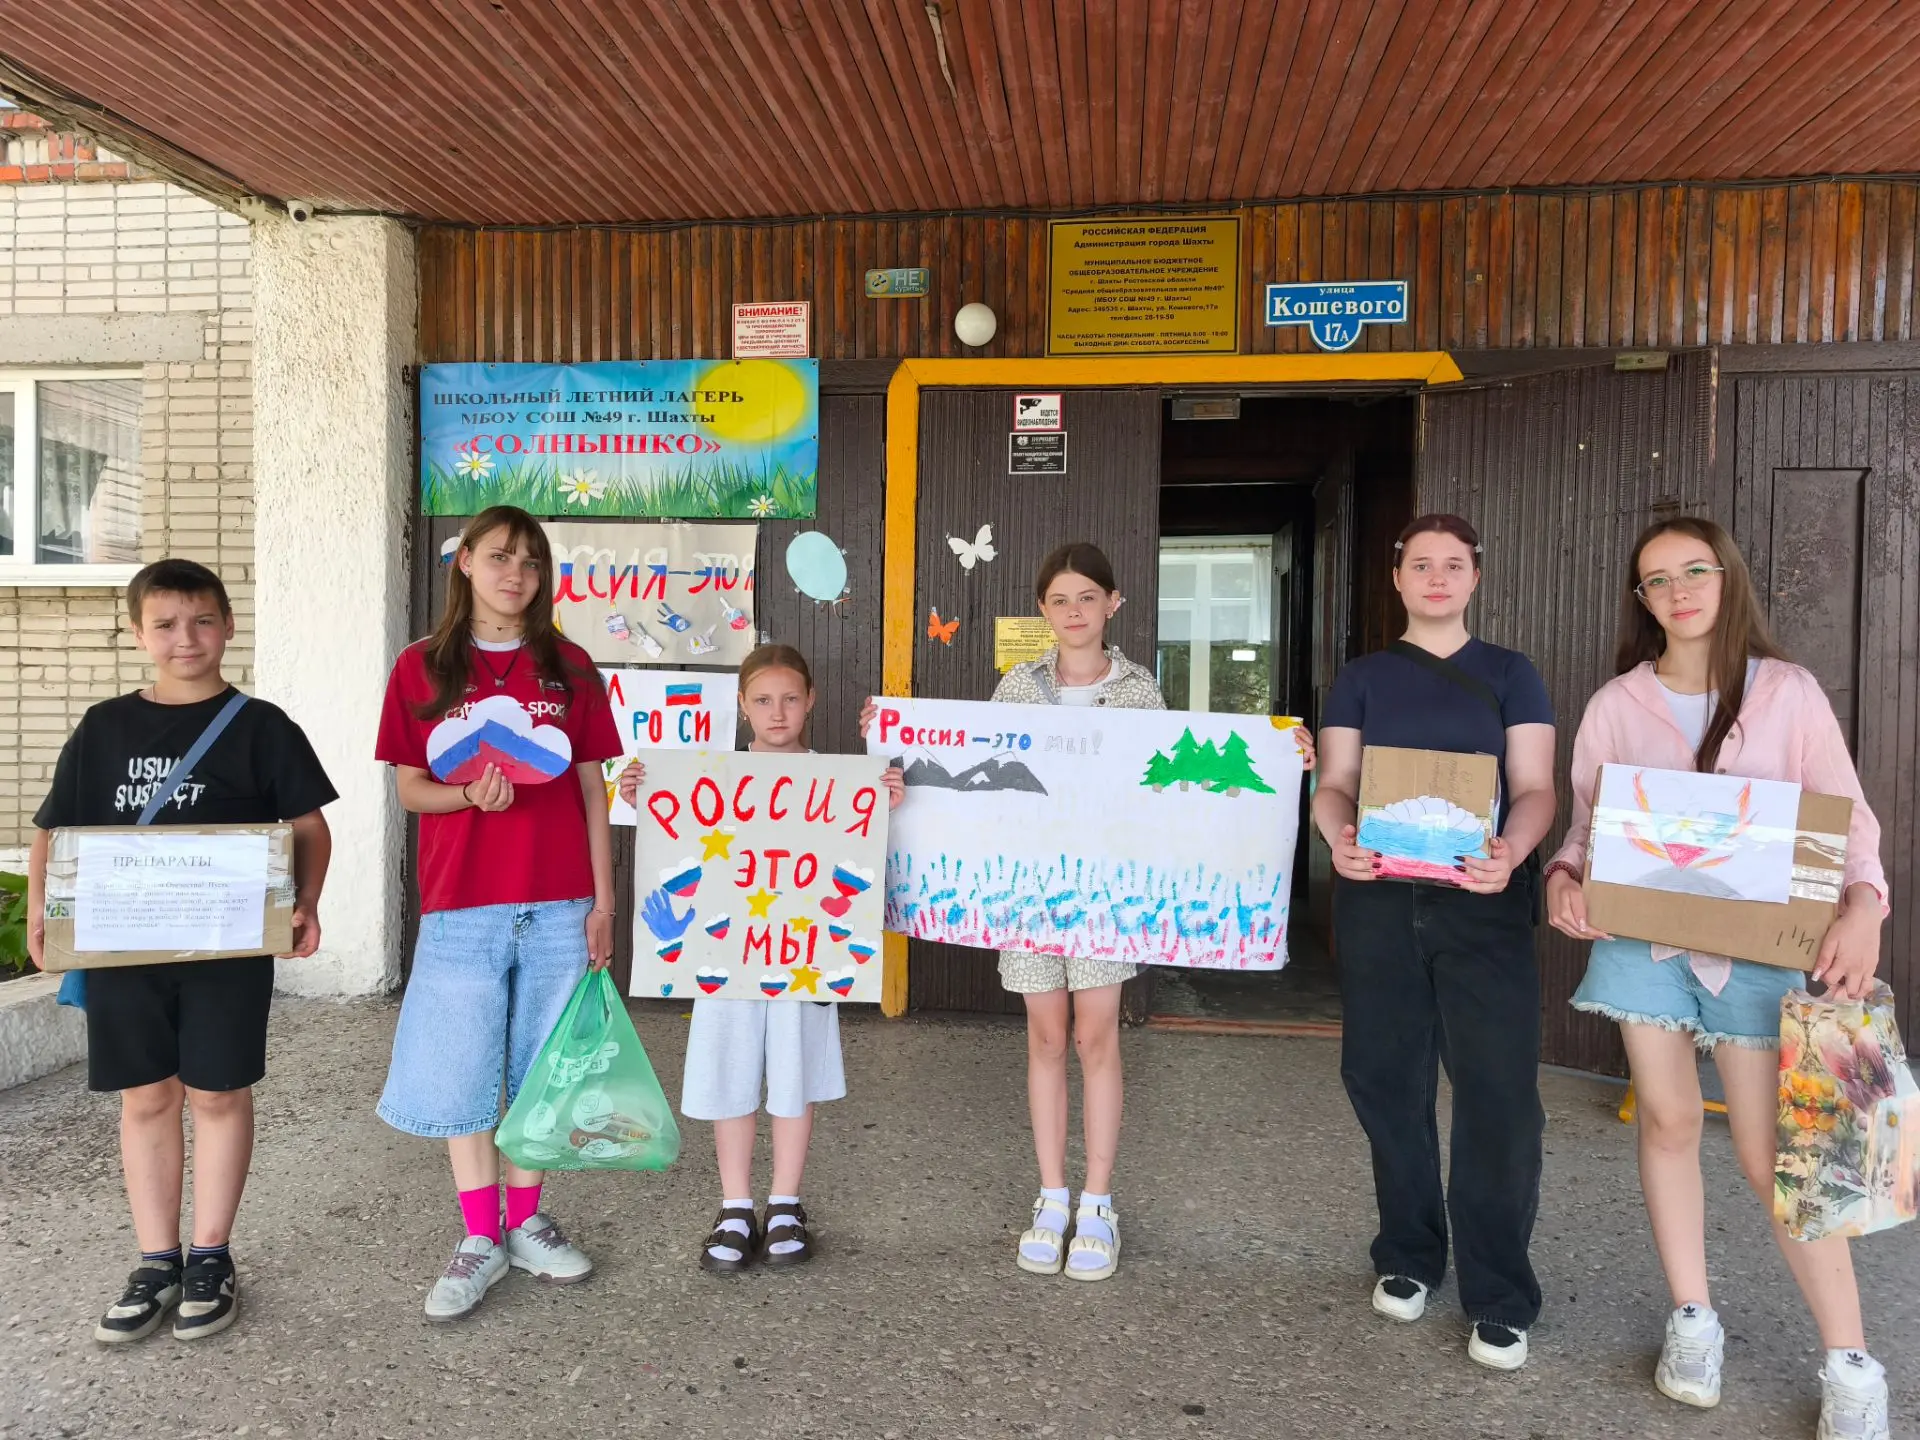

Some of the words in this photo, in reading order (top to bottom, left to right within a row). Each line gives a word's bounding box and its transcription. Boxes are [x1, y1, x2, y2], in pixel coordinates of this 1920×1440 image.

[1082, 226, 1145, 236] РОССИЙСКАЯ
[1148, 226, 1207, 235] ФЕДЕРАЦИЯ
[1074, 240, 1146, 249] Администрация
[1149, 240, 1180, 248] города
[1183, 238, 1214, 246] Шахты
[1084, 258, 1152, 267] МУНИЦИПАЛЬНОЕ
[1153, 257, 1204, 265] БЮДЖЕТНОЕ
[1069, 267, 1165, 277] ОБЩЕОБРАЗОВАТЕЛЬНОЕ
[1167, 266, 1219, 275] УЧРЕЖДЕНИЕ
[1320, 287, 1355, 296] улица
[738, 306, 803, 317] ВНИМАНИЕ!
[1273, 296, 1401, 316] Кошевого
[434, 389, 562, 405] ШКОЛЬНЫЙ
[566, 388, 654, 403] ЛЕТНИЙ
[659, 390, 745, 403] ЛАГЕРЬ
[461, 411, 520, 425] МБОУ
[525, 411, 576, 424] СОШ
[581, 411, 623, 424] №49
[627, 414, 641, 423] г.
[647, 411, 717, 424] Шахты
[452, 433, 722, 455] «СОЛНЫШКО»
[128, 756, 193, 783] USU
[114, 781, 206, 812] SUSPCT
[647, 775, 877, 841] РОССИЯ
[112, 855, 213, 869] ПРЕПАРАТЫ
[733, 849, 818, 889] ЭТО
[742, 923, 819, 966] МЫ
